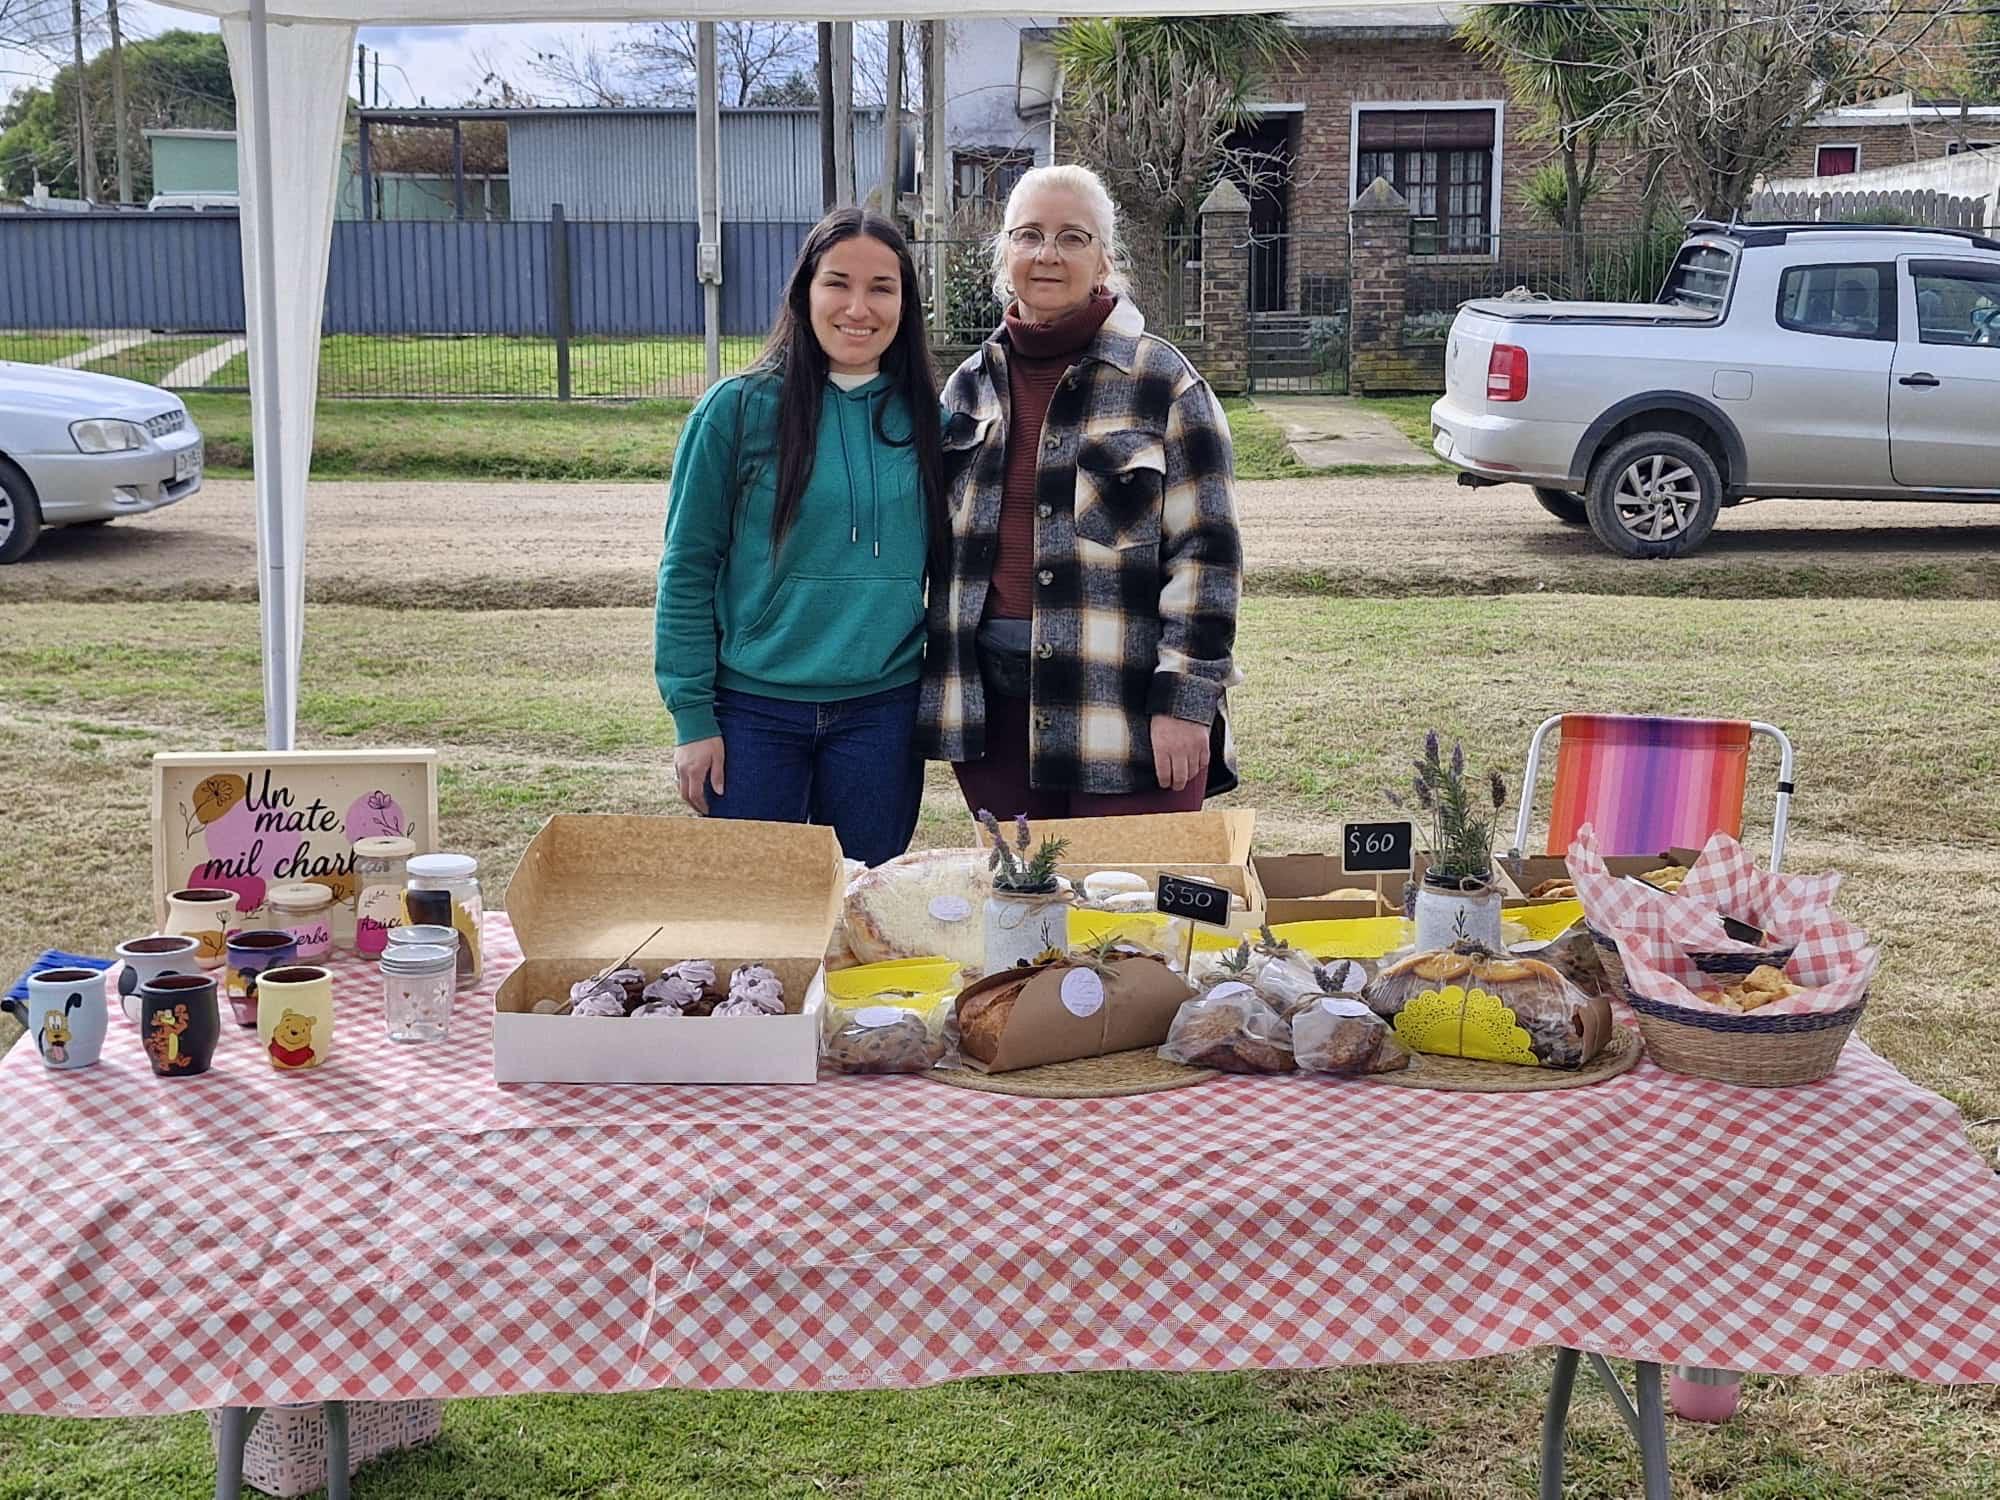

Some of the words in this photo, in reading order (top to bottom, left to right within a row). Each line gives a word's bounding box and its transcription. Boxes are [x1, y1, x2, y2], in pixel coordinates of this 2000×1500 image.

[245, 768, 296, 812] Un
[254, 798, 346, 834] mate,
[1349, 825, 1395, 857] $60
[203, 838, 264, 881] mil
[1161, 877, 1213, 909] $50
[293, 926, 329, 946] erba
